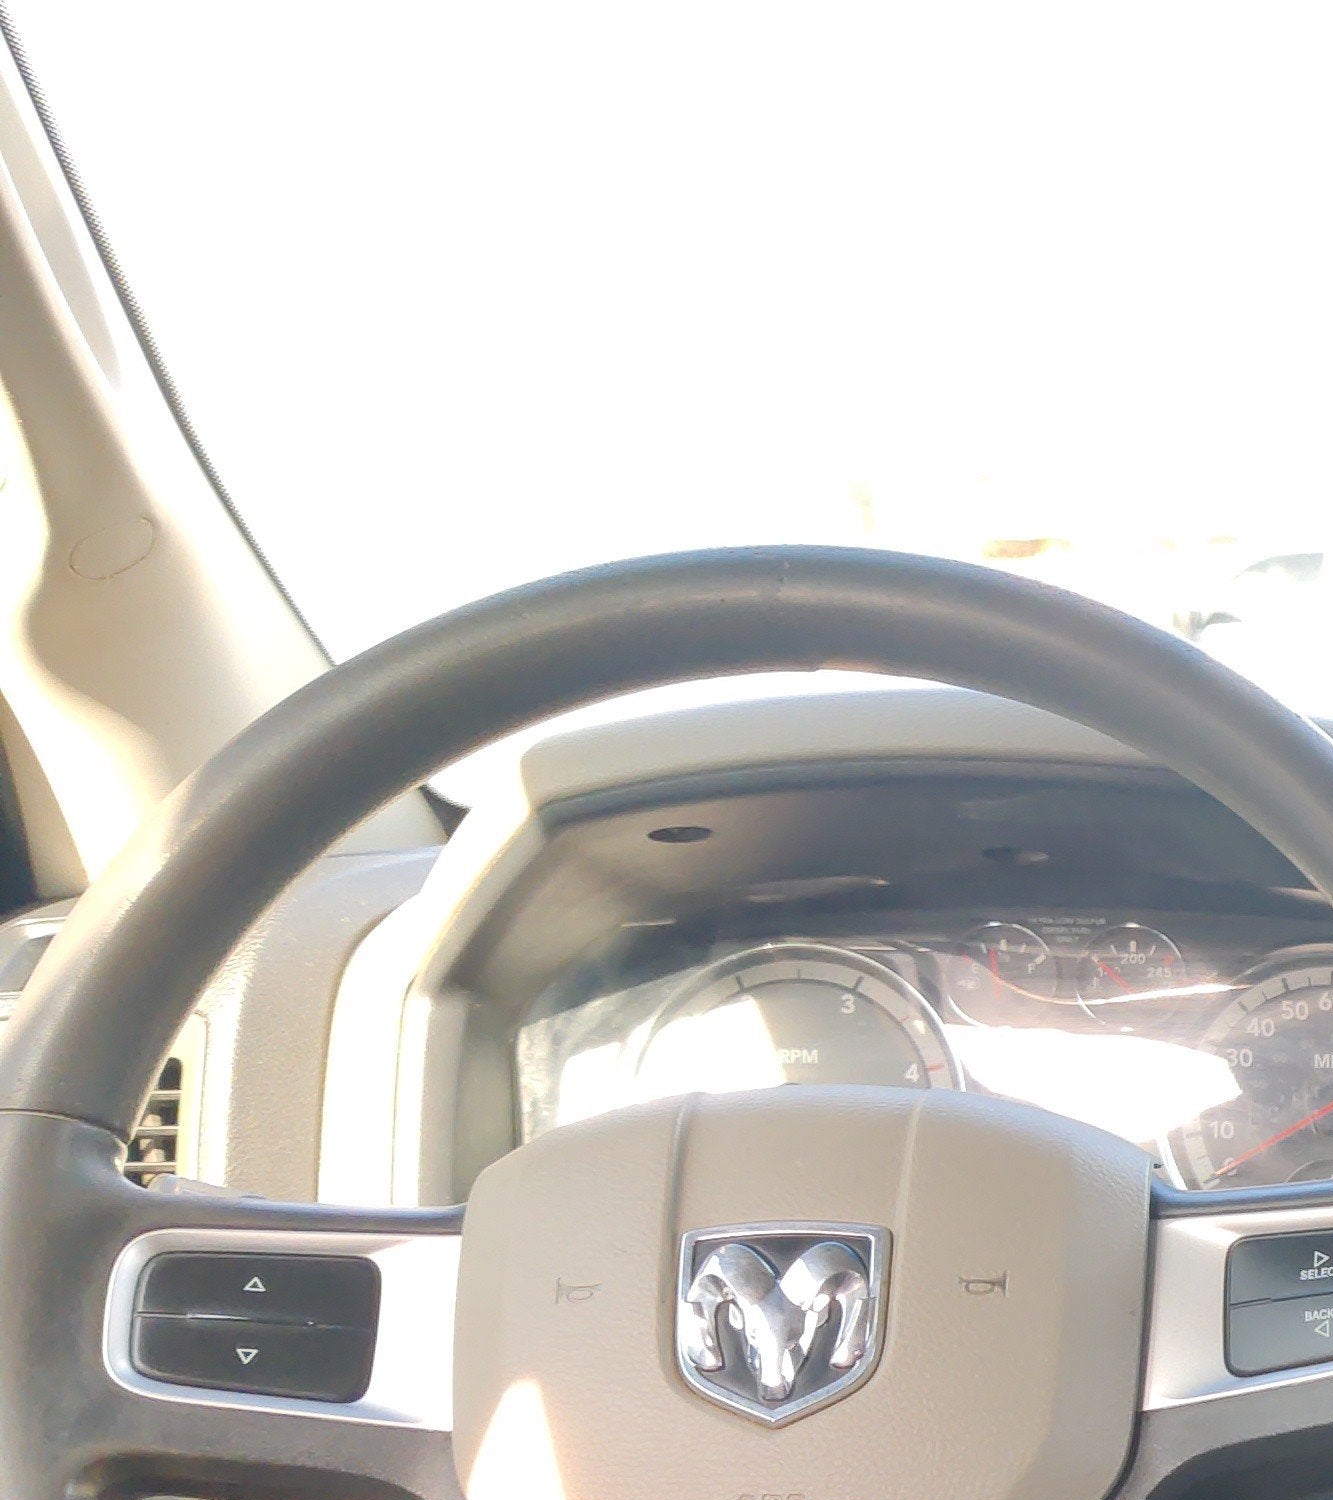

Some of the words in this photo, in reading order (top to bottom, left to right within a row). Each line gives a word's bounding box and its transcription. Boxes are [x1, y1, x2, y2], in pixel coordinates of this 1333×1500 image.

[1120, 953, 1146, 964] 200
[1147, 966, 1172, 978] 245
[841, 993, 856, 1015] 3
[1281, 1001, 1309, 1021] 50
[1246, 1018, 1275, 1037] 40
[777, 1049, 819, 1065] RPM
[1226, 1048, 1253, 1068] 30
[905, 1062, 921, 1083] 4
[1208, 1120, 1235, 1140] 10
